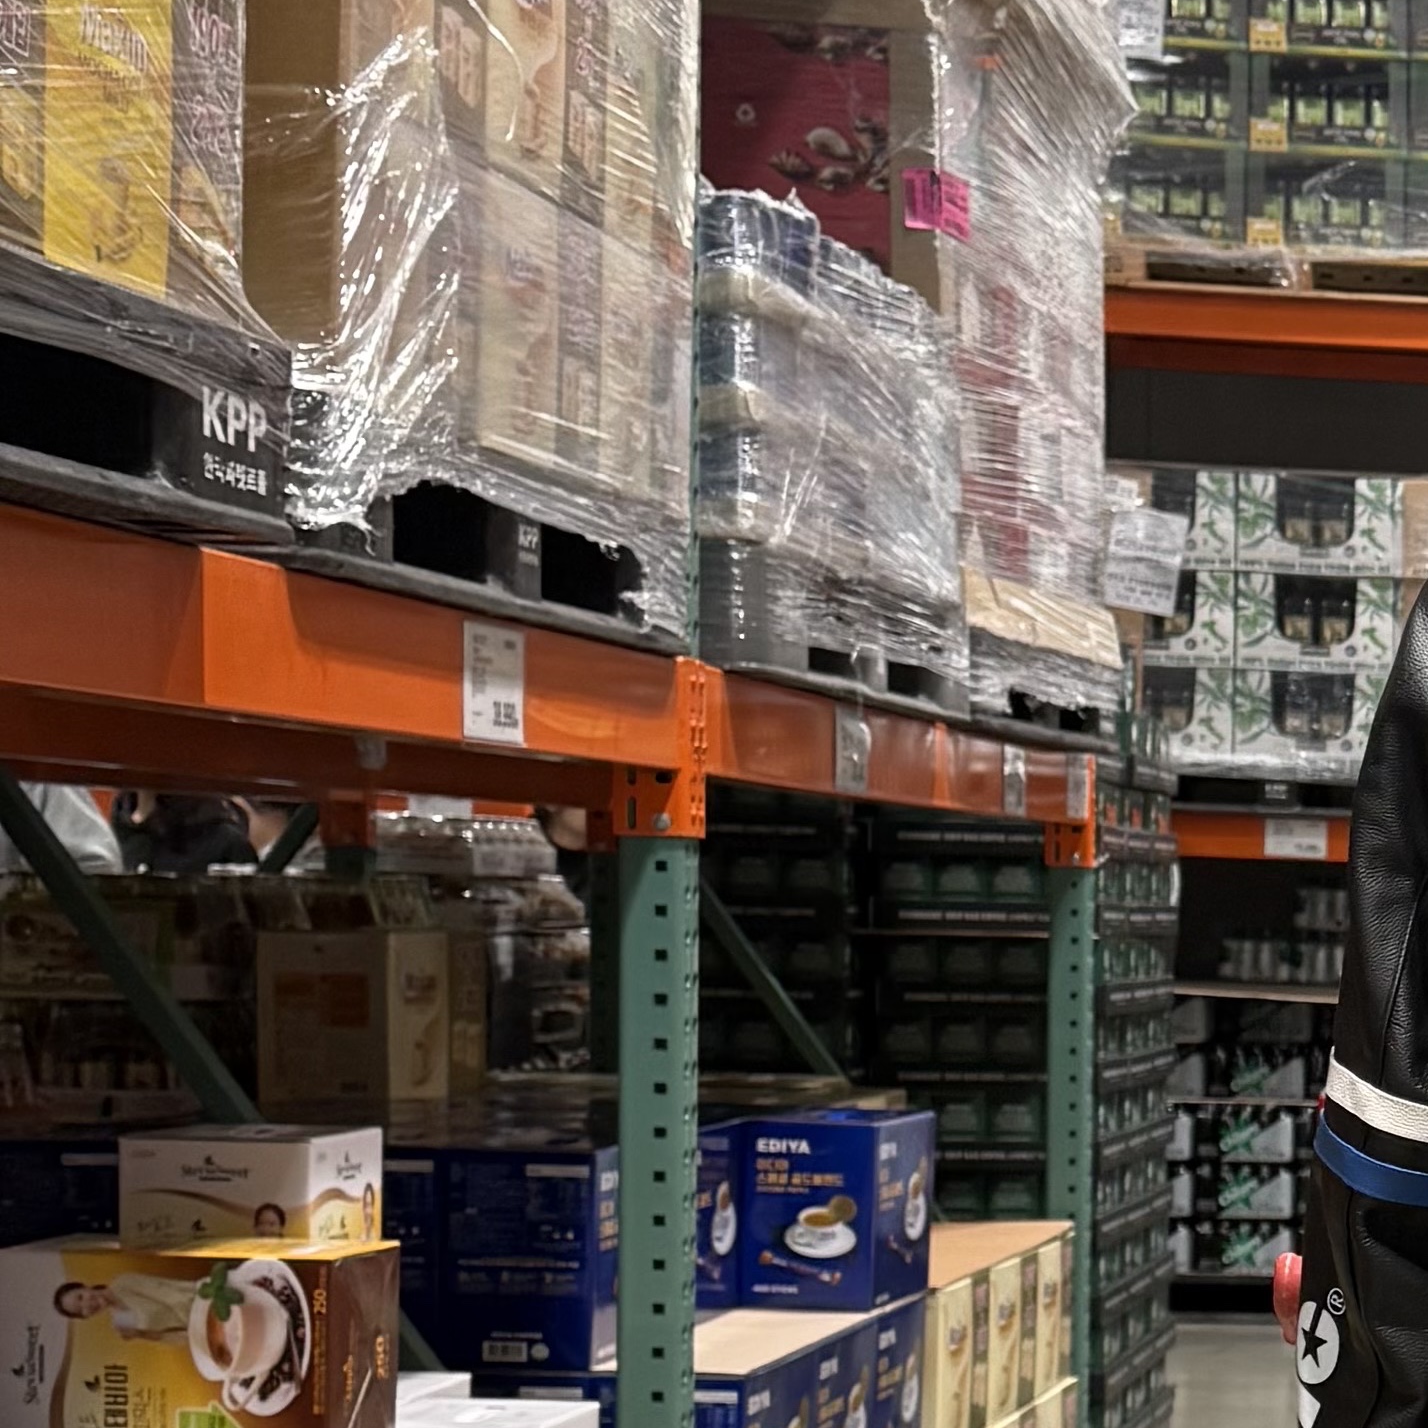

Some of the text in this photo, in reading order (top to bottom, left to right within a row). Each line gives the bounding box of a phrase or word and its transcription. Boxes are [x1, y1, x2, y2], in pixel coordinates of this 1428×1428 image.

[201, 385, 268, 453] KPP
[755, 1137, 811, 1155] EDIYA
[313, 1288, 327, 1315] 250
